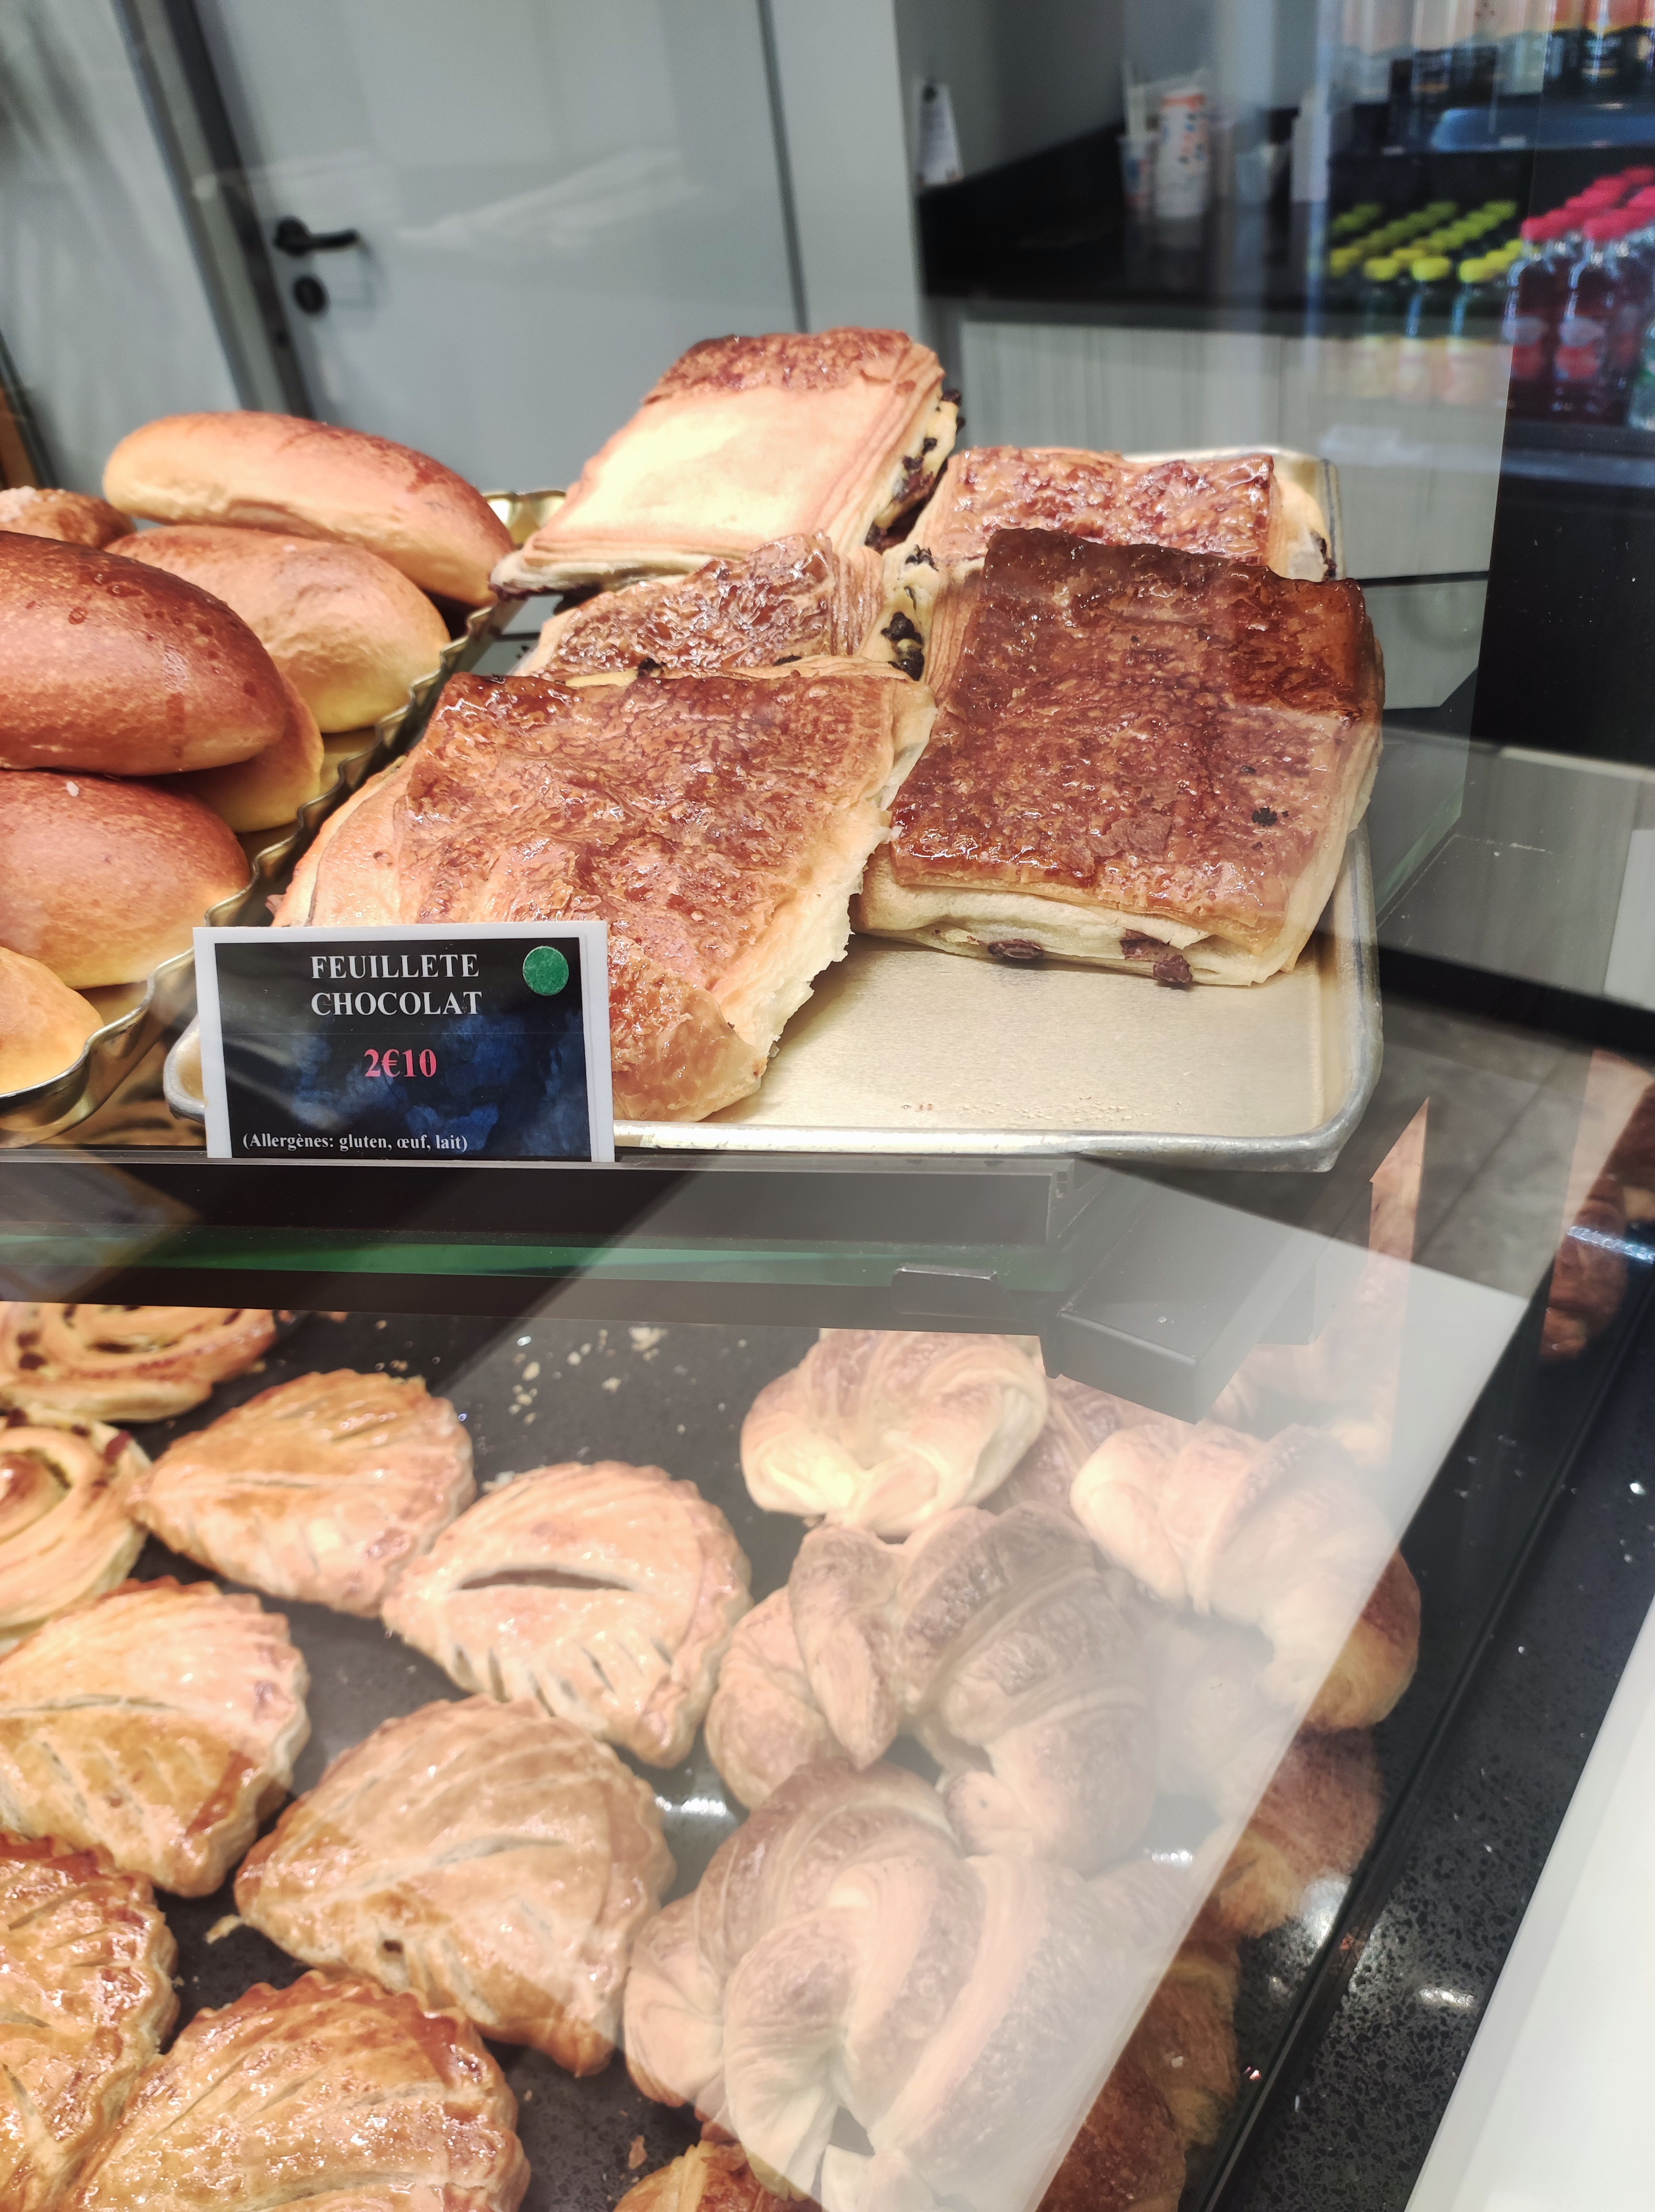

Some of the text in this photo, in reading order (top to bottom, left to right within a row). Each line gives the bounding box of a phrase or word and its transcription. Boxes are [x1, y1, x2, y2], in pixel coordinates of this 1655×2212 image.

[310, 953, 480, 979] FEUILLETE
[311, 991, 482, 1016] CHOCOLAT
[364, 1048, 437, 1078] 2€10
[242, 1133, 468, 1153] (Allergènes: gluten, œuf, lait)
